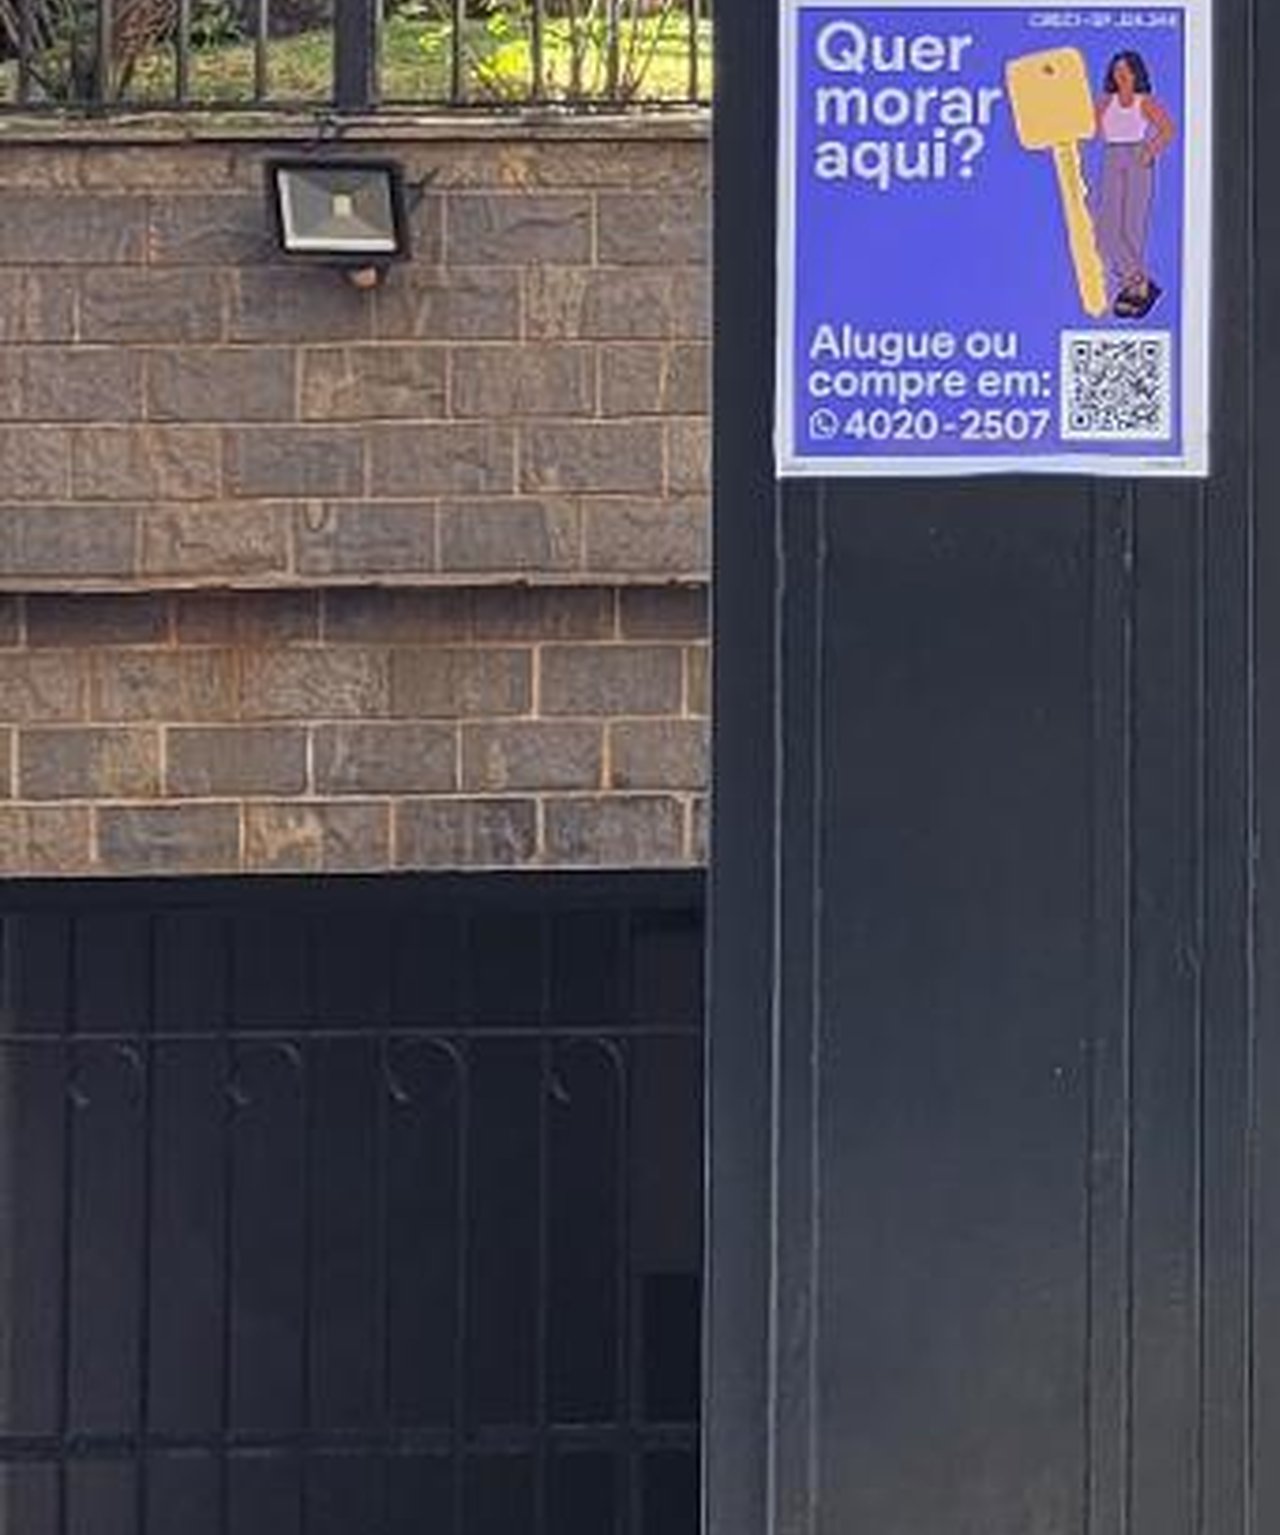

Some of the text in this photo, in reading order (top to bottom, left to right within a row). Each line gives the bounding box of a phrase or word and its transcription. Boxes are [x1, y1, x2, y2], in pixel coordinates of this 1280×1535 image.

[815, 21, 973, 73] Quer
[815, 86, 1002, 126] morar
[814, 131, 985, 191] aqui?
[809, 324, 1017, 364] Alugue ou
[808, 369, 1052, 403] compre em:
